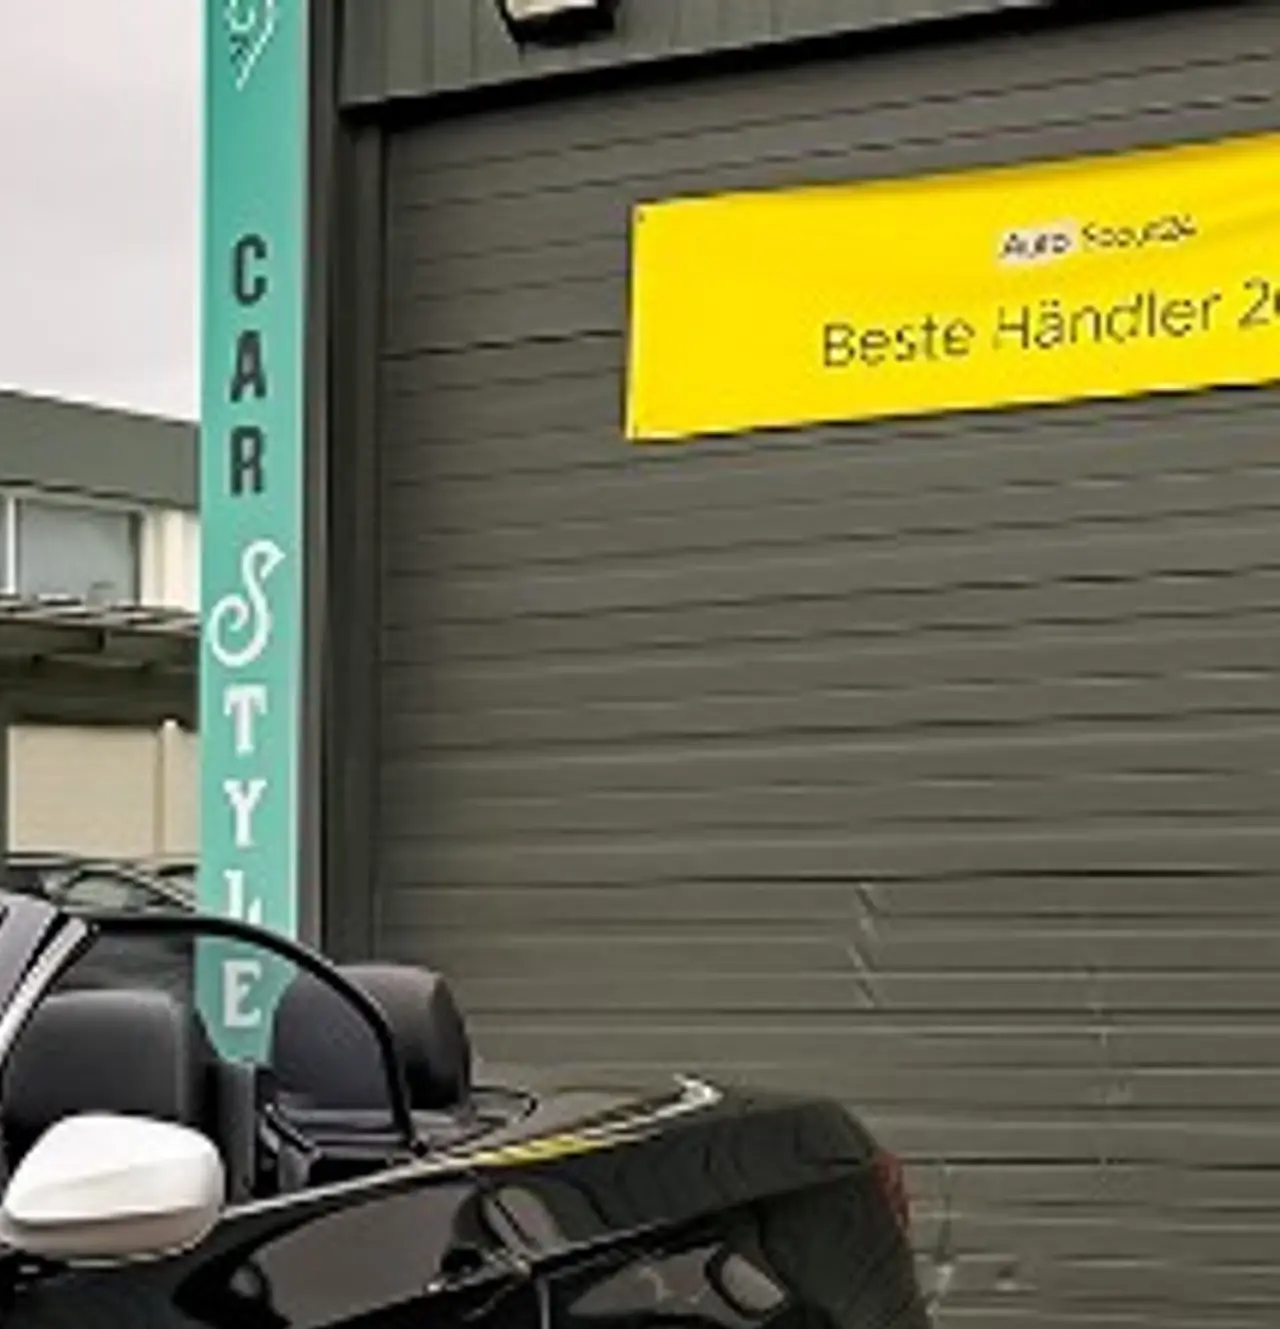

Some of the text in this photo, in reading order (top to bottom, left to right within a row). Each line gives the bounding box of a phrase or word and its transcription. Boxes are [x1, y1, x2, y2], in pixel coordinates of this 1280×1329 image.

[823, 277, 1280, 369] Beste Händler 2
[209, 233, 286, 1028] CAR STYLE
